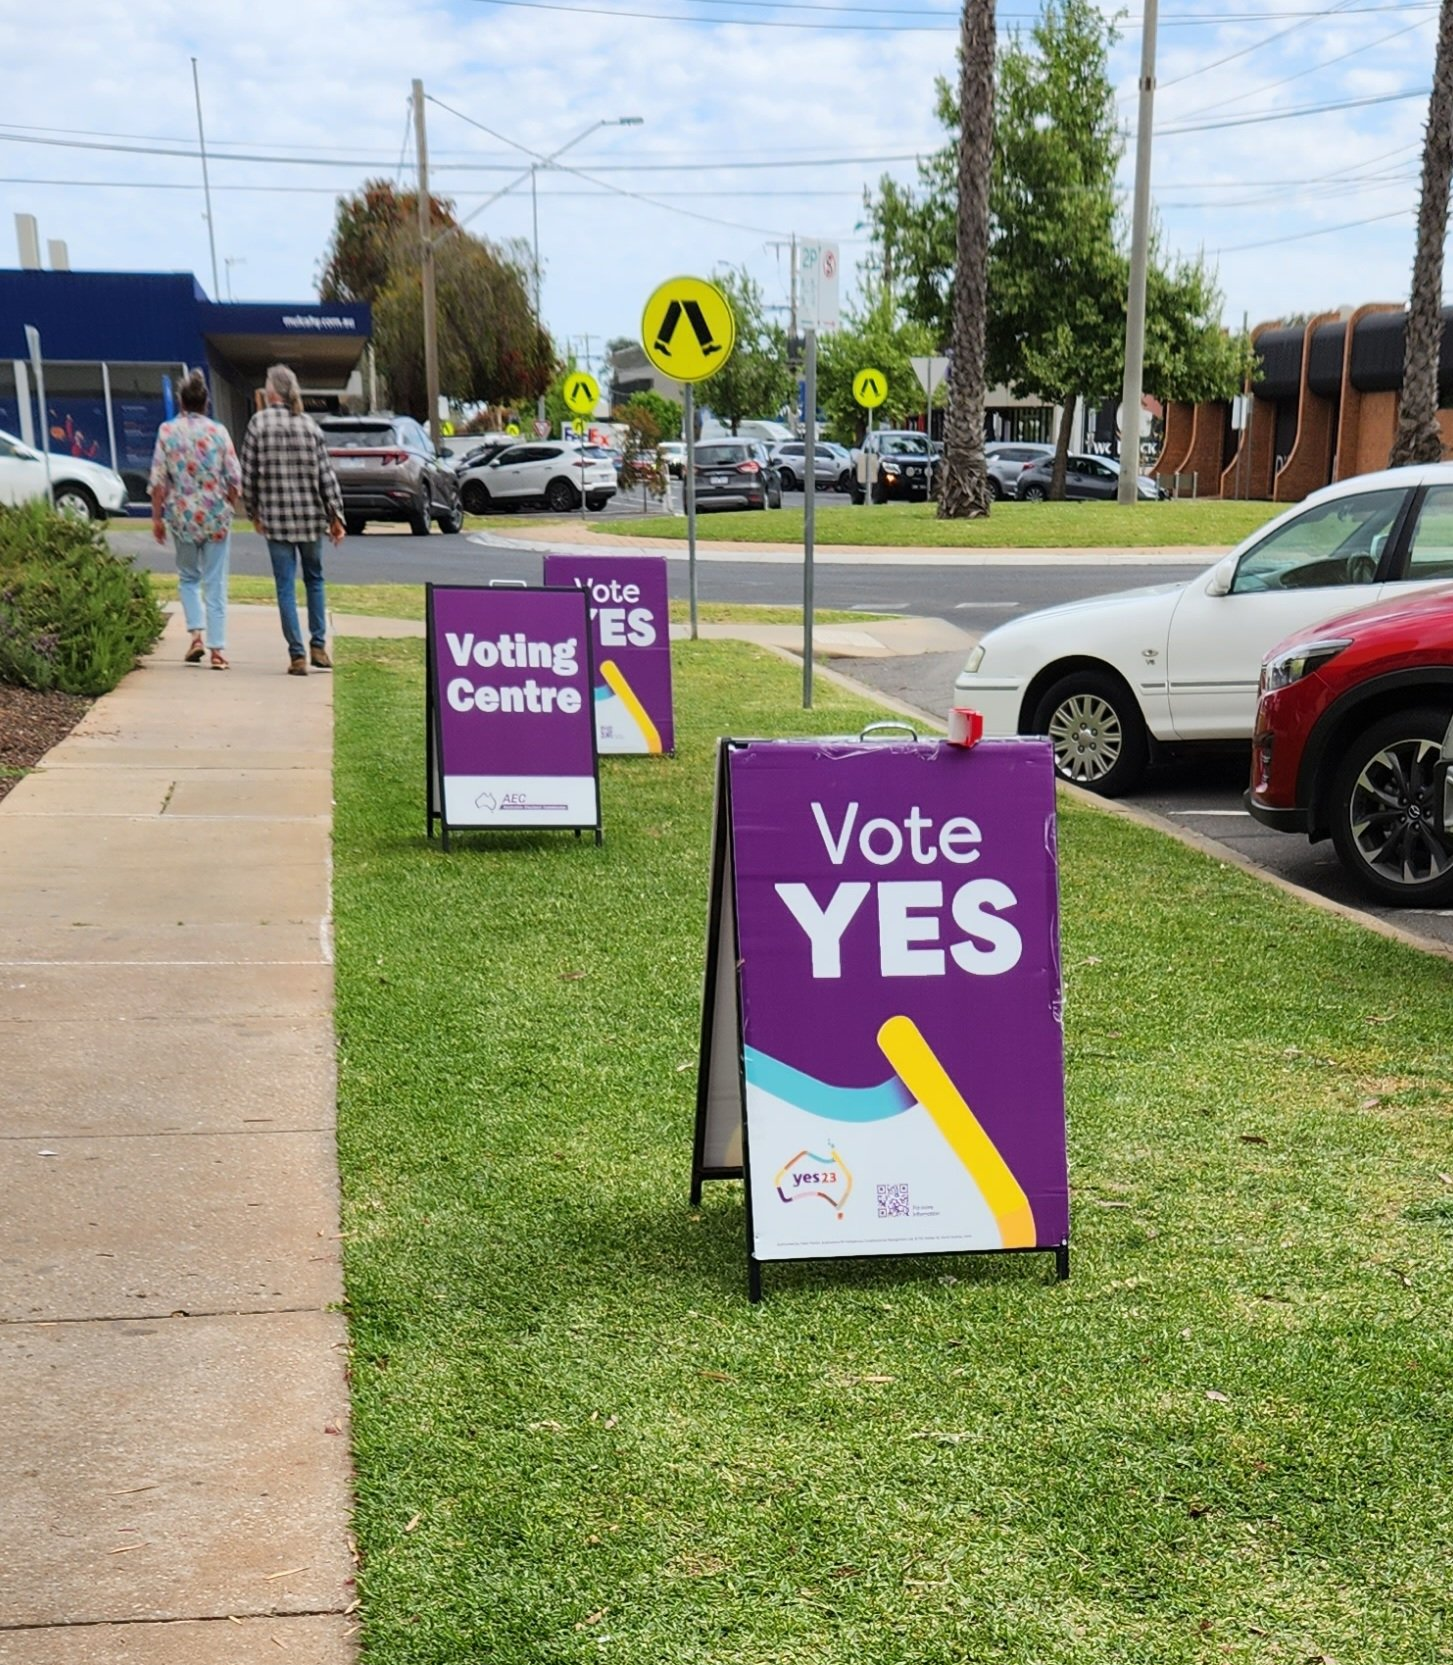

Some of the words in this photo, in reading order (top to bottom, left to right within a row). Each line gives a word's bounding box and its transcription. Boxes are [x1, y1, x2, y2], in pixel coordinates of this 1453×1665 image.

[445, 633, 579, 676] Voting
[447, 679, 581, 713] Centre
[503, 793, 527, 804] AEC
[811, 801, 983, 866] Vote
[774, 878, 1023, 979] YES
[792, 1172, 837, 1187] yes23
